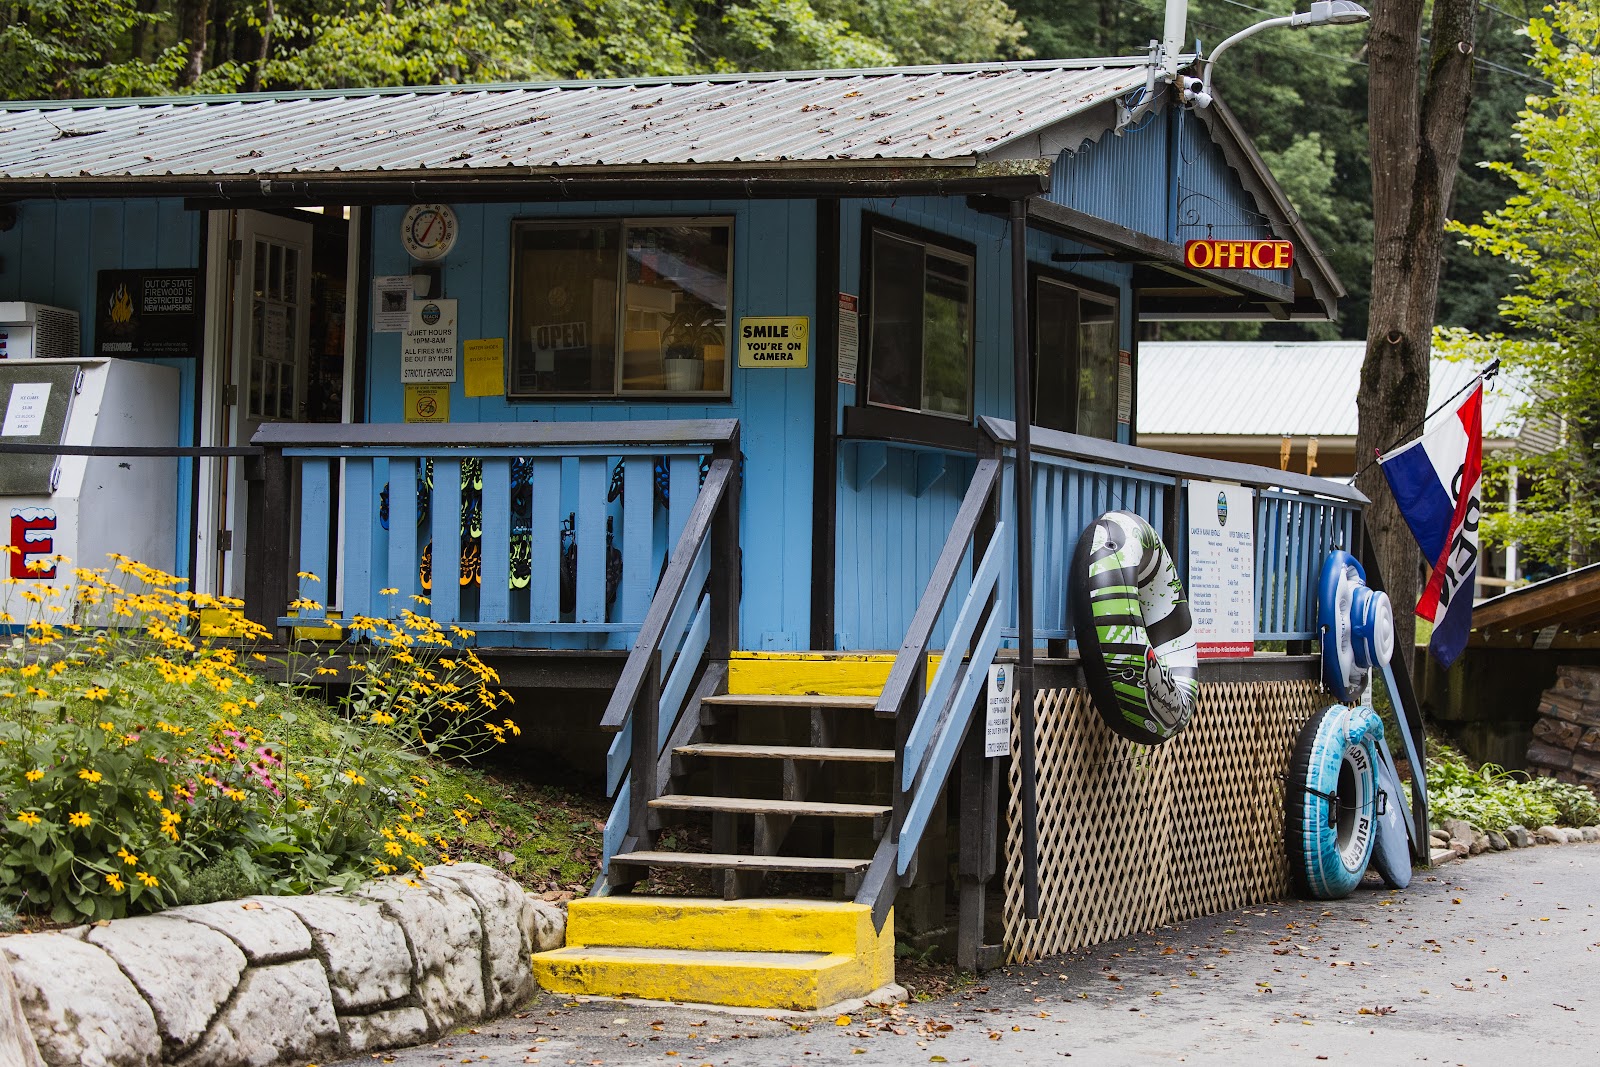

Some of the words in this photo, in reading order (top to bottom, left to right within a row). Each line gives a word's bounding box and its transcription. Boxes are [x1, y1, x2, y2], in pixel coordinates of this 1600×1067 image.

[1188, 241, 1290, 268] OFFICE
[145, 280, 160, 288] OUT
[161, 280, 170, 288] OF
[172, 280, 192, 288] STATE
[537, 324, 584, 350] OPEN
[743, 325, 788, 338] SMILE
[405, 369, 426, 378] STRICTLY
